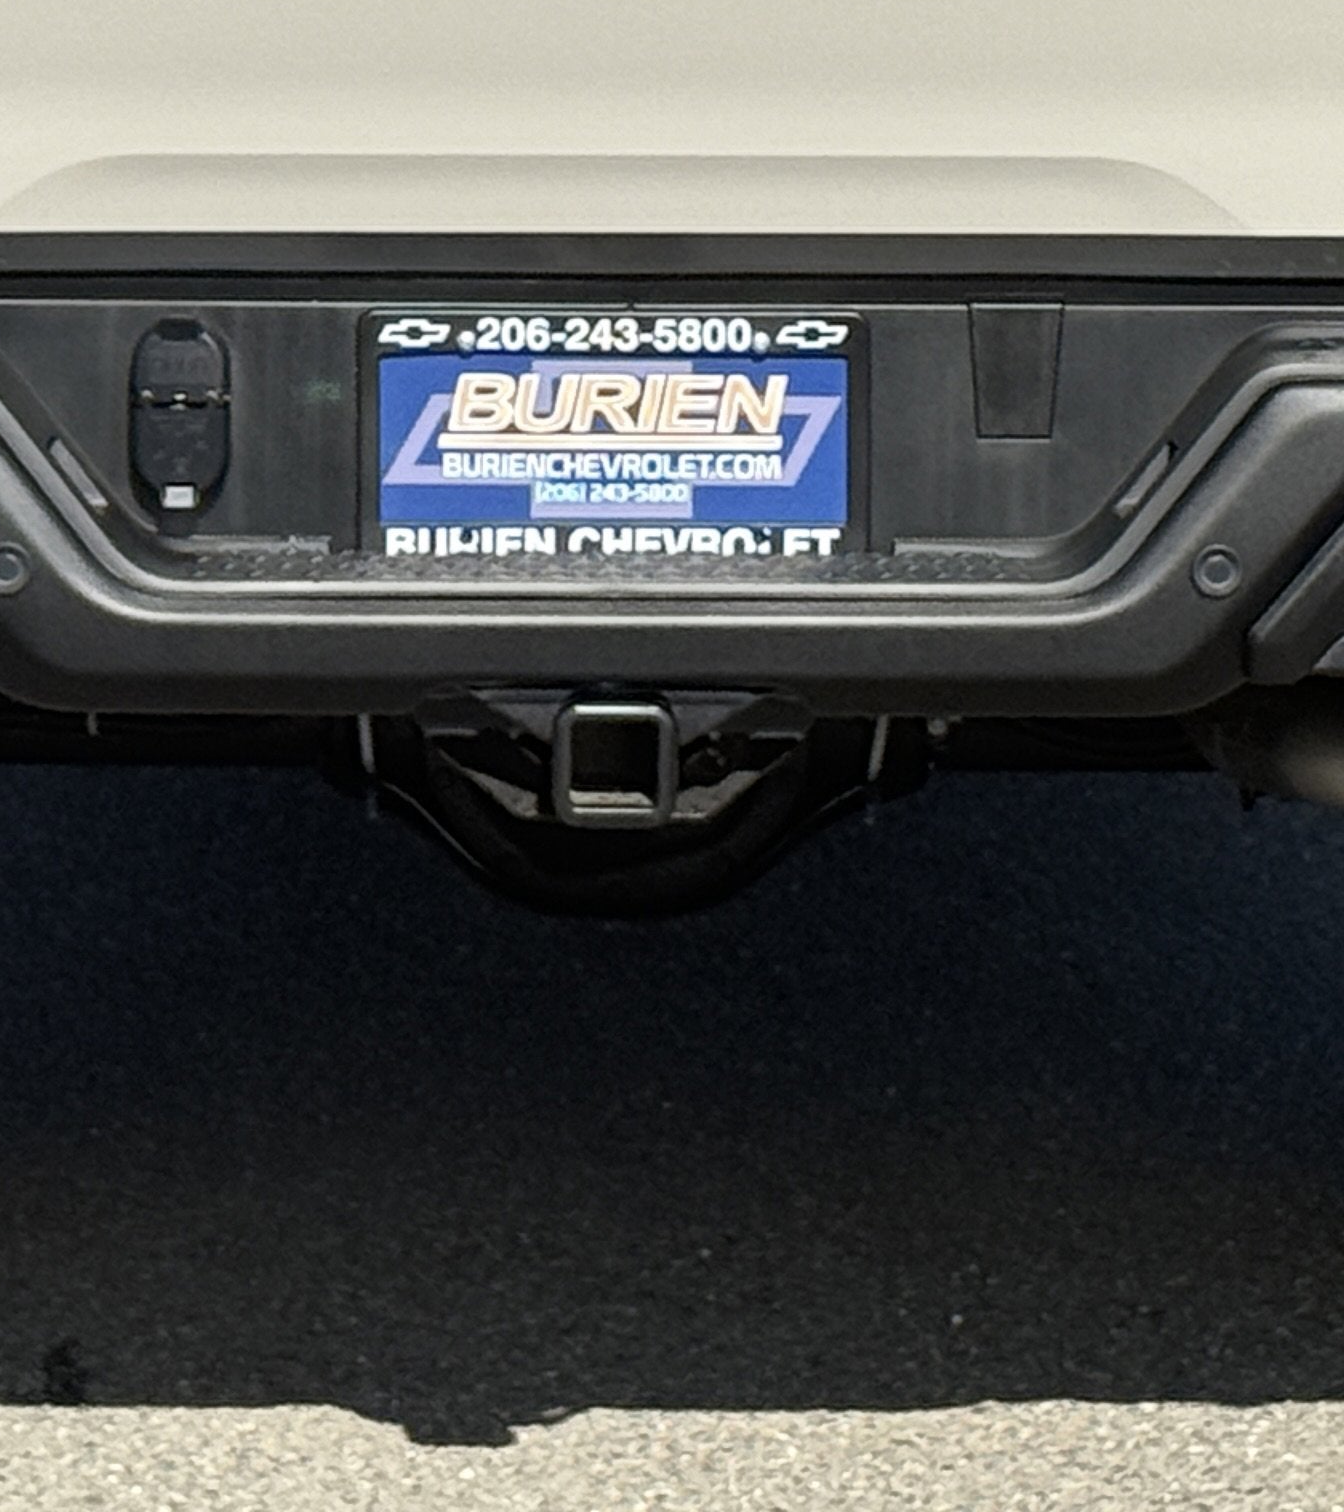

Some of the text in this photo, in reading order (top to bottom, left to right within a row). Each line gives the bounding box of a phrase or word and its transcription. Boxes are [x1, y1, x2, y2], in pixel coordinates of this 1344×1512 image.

[475, 316, 753, 353] 206-243-5800
[447, 372, 789, 434] BURIEN
[442, 453, 782, 481] BURIENCHEVROLET.COM
